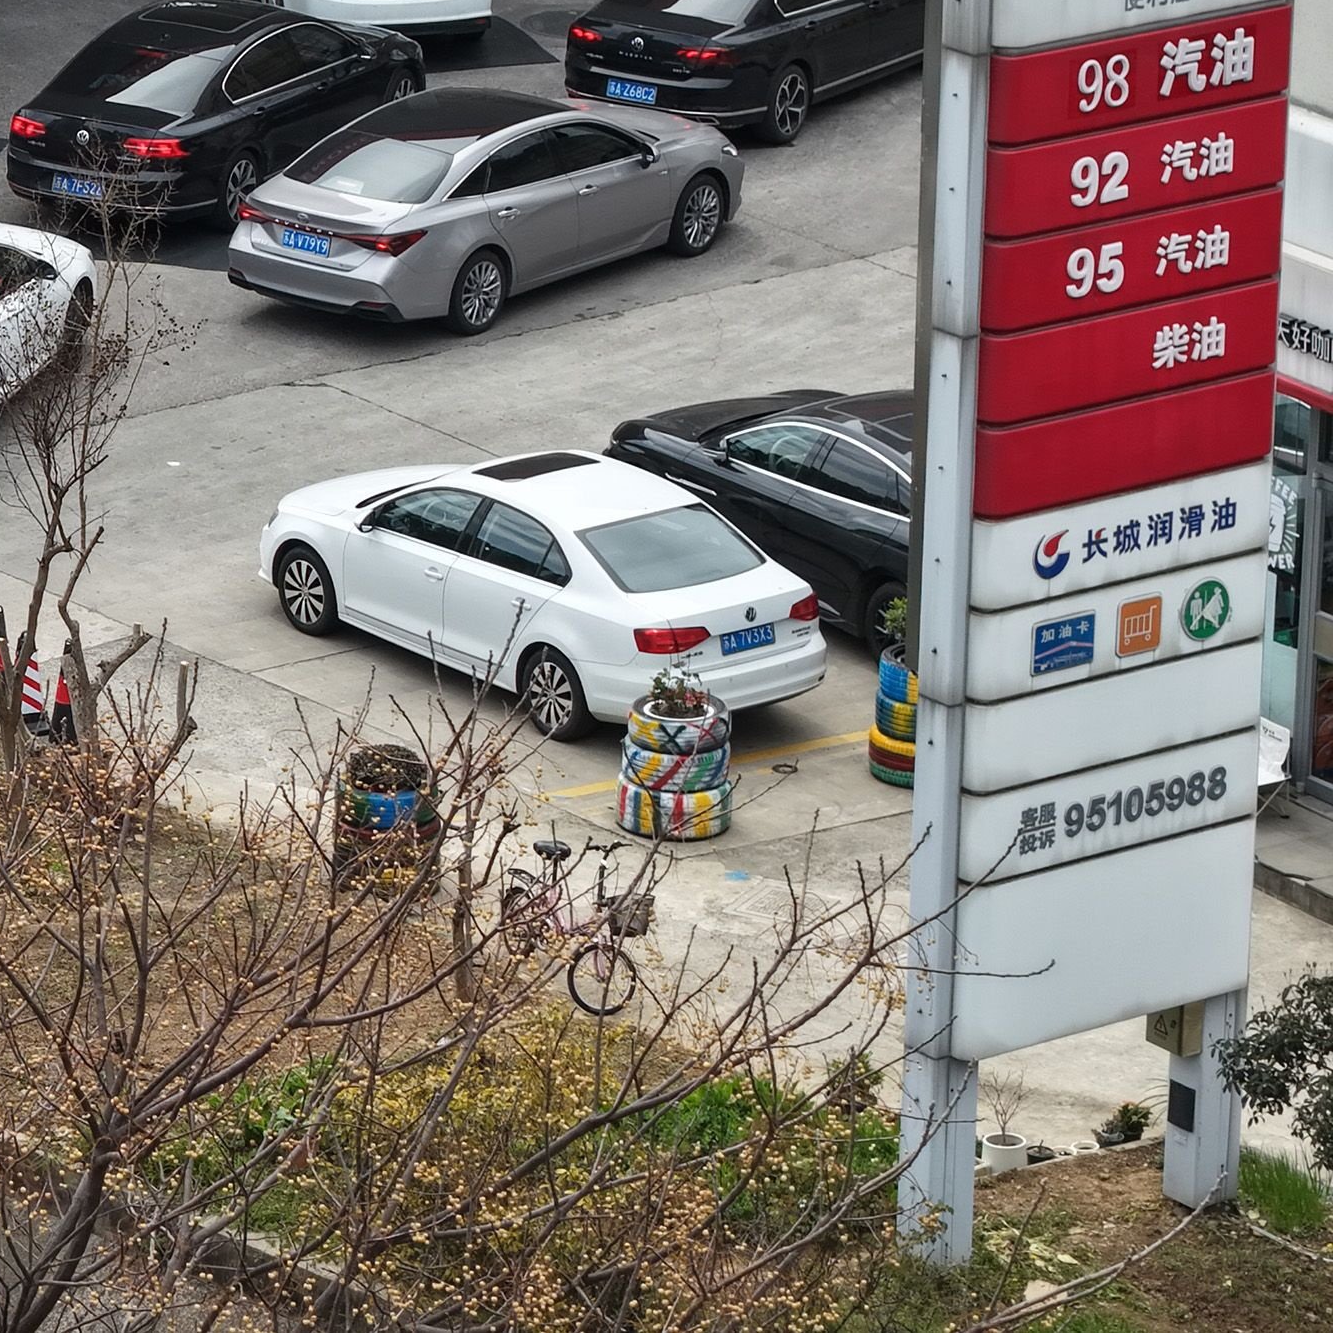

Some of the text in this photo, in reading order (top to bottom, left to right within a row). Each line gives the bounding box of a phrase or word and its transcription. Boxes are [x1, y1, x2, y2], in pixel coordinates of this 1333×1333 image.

[1075, 26, 1255, 114] 98 汽油
[1069, 130, 1236, 209] 92 汽油
[1064, 224, 1230, 300] 95 汽油
[1152, 314, 1227, 371] 柴油
[1278, 319, 1333, 365] 天好咖
[1081, 497, 1238, 565] 长城润滑油
[1040, 620, 1091, 645] 加油卡
[1020, 801, 1057, 827] 客服
[1063, 765, 1228, 840] 95105988
[1019, 830, 1057, 857] 投诉
